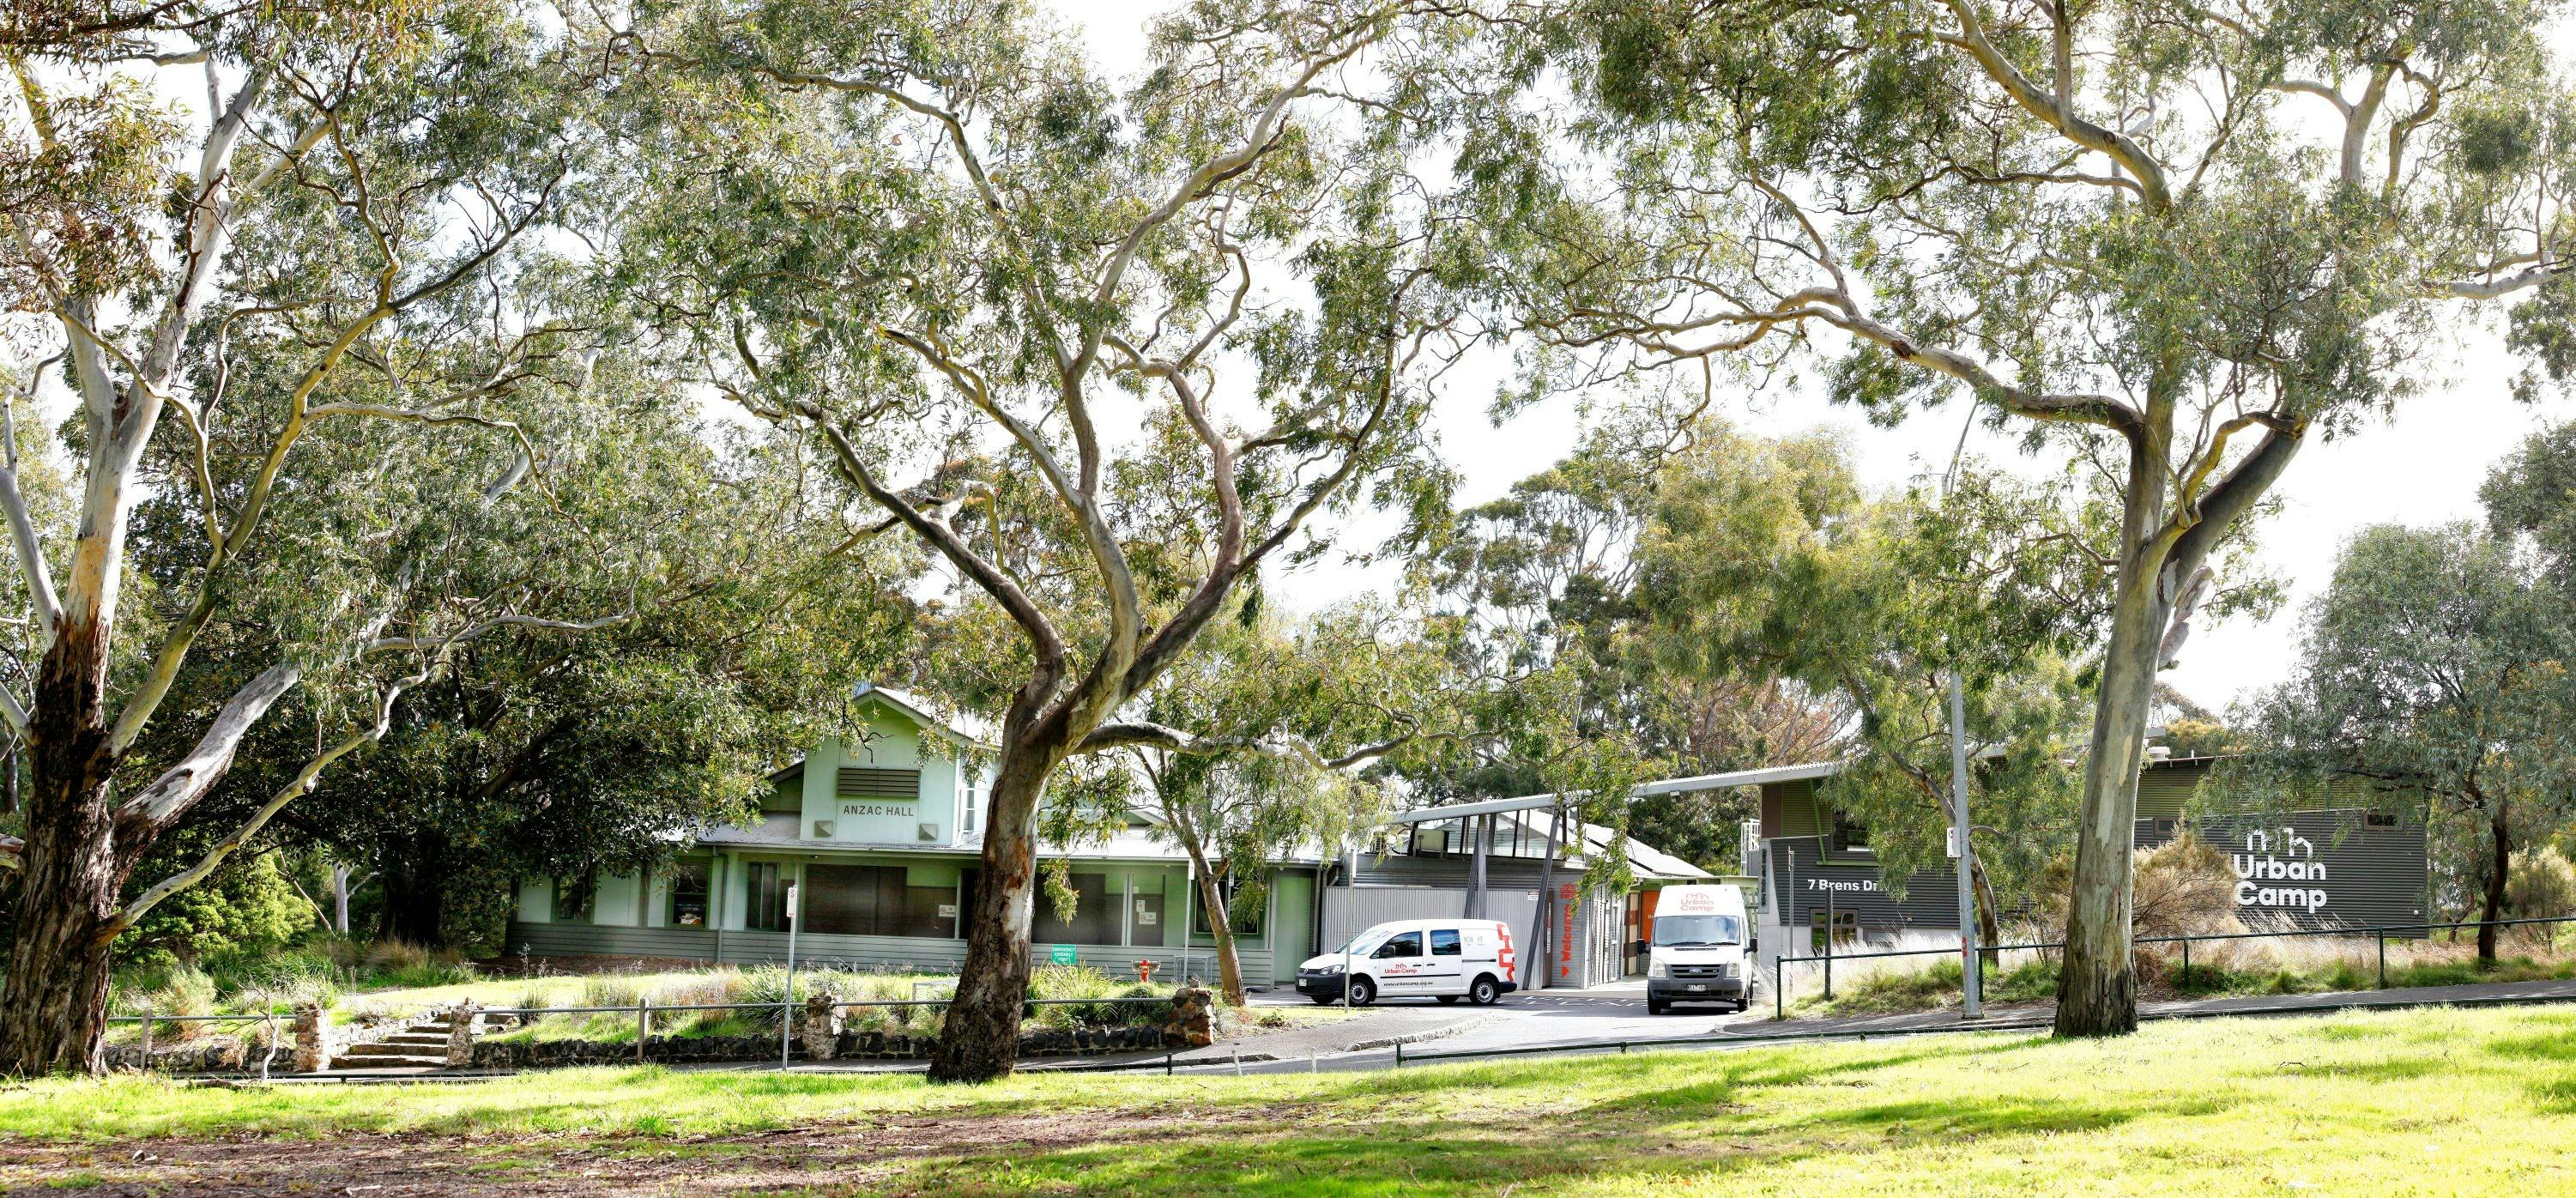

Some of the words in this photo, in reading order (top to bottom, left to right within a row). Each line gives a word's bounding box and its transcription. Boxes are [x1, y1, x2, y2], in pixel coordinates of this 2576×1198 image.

[844, 805, 882, 815] ANZAC
[886, 806, 915, 817] HALL
[2233, 854, 2326, 880] Urban
[1807, 879, 1816, 890] 7
[1819, 879, 1860, 891] Brens
[2234, 880, 2327, 914] Camp
